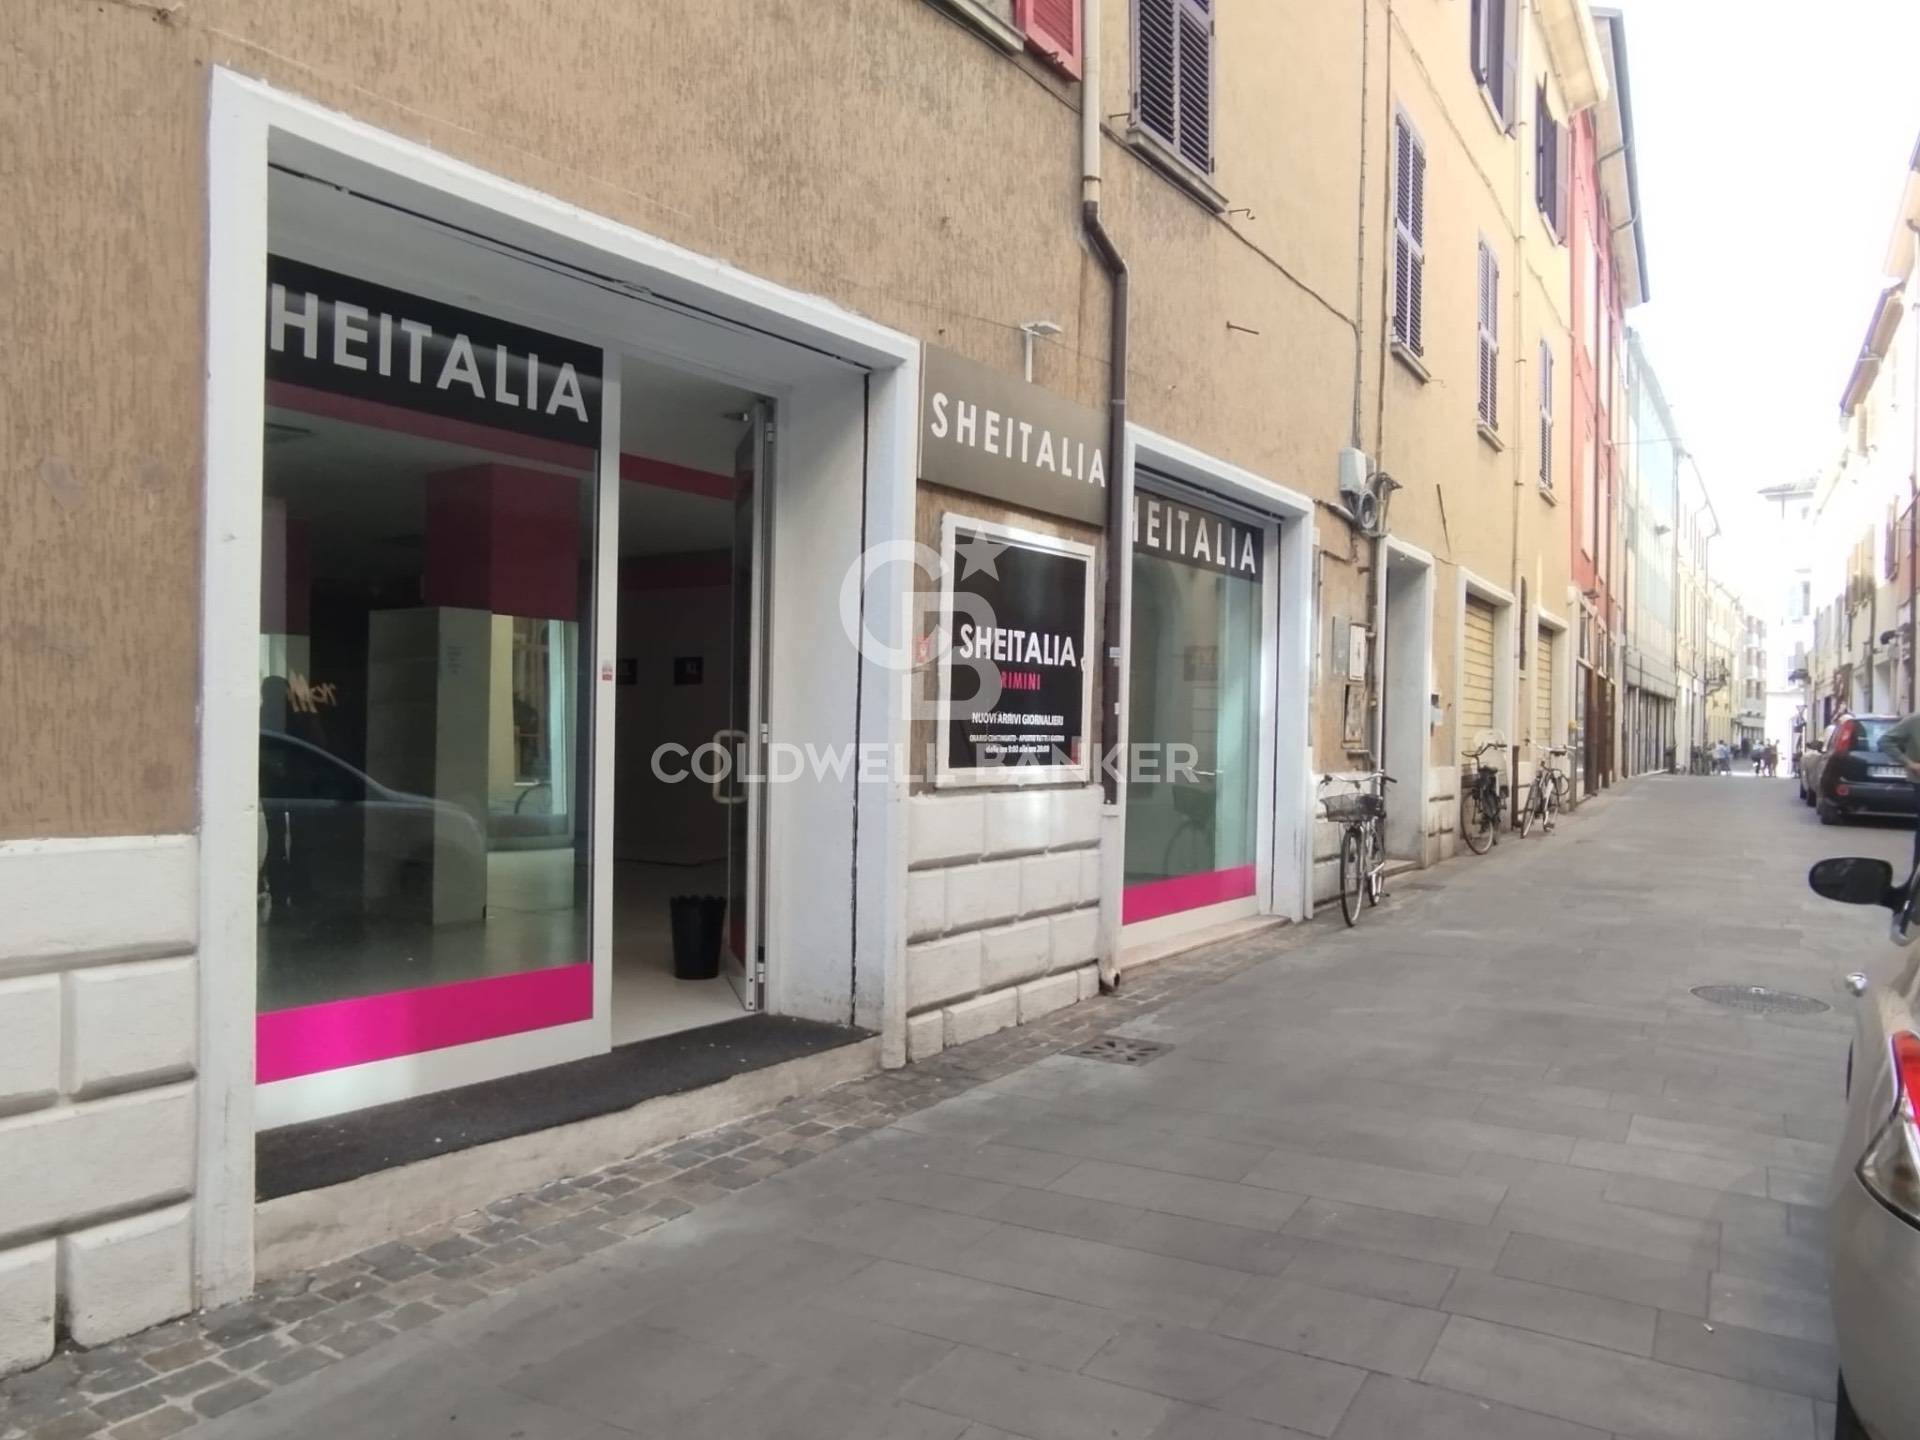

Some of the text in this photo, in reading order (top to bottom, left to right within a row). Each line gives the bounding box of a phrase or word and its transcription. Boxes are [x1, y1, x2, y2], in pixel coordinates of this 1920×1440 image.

[930, 391, 1107, 488] SHEITALIA
[960, 624, 1076, 667] SHEITALIA
[1000, 671, 1041, 690] RIMINI
[971, 712, 997, 724] NUOVI
[997, 713, 1021, 725] ARRIVI
